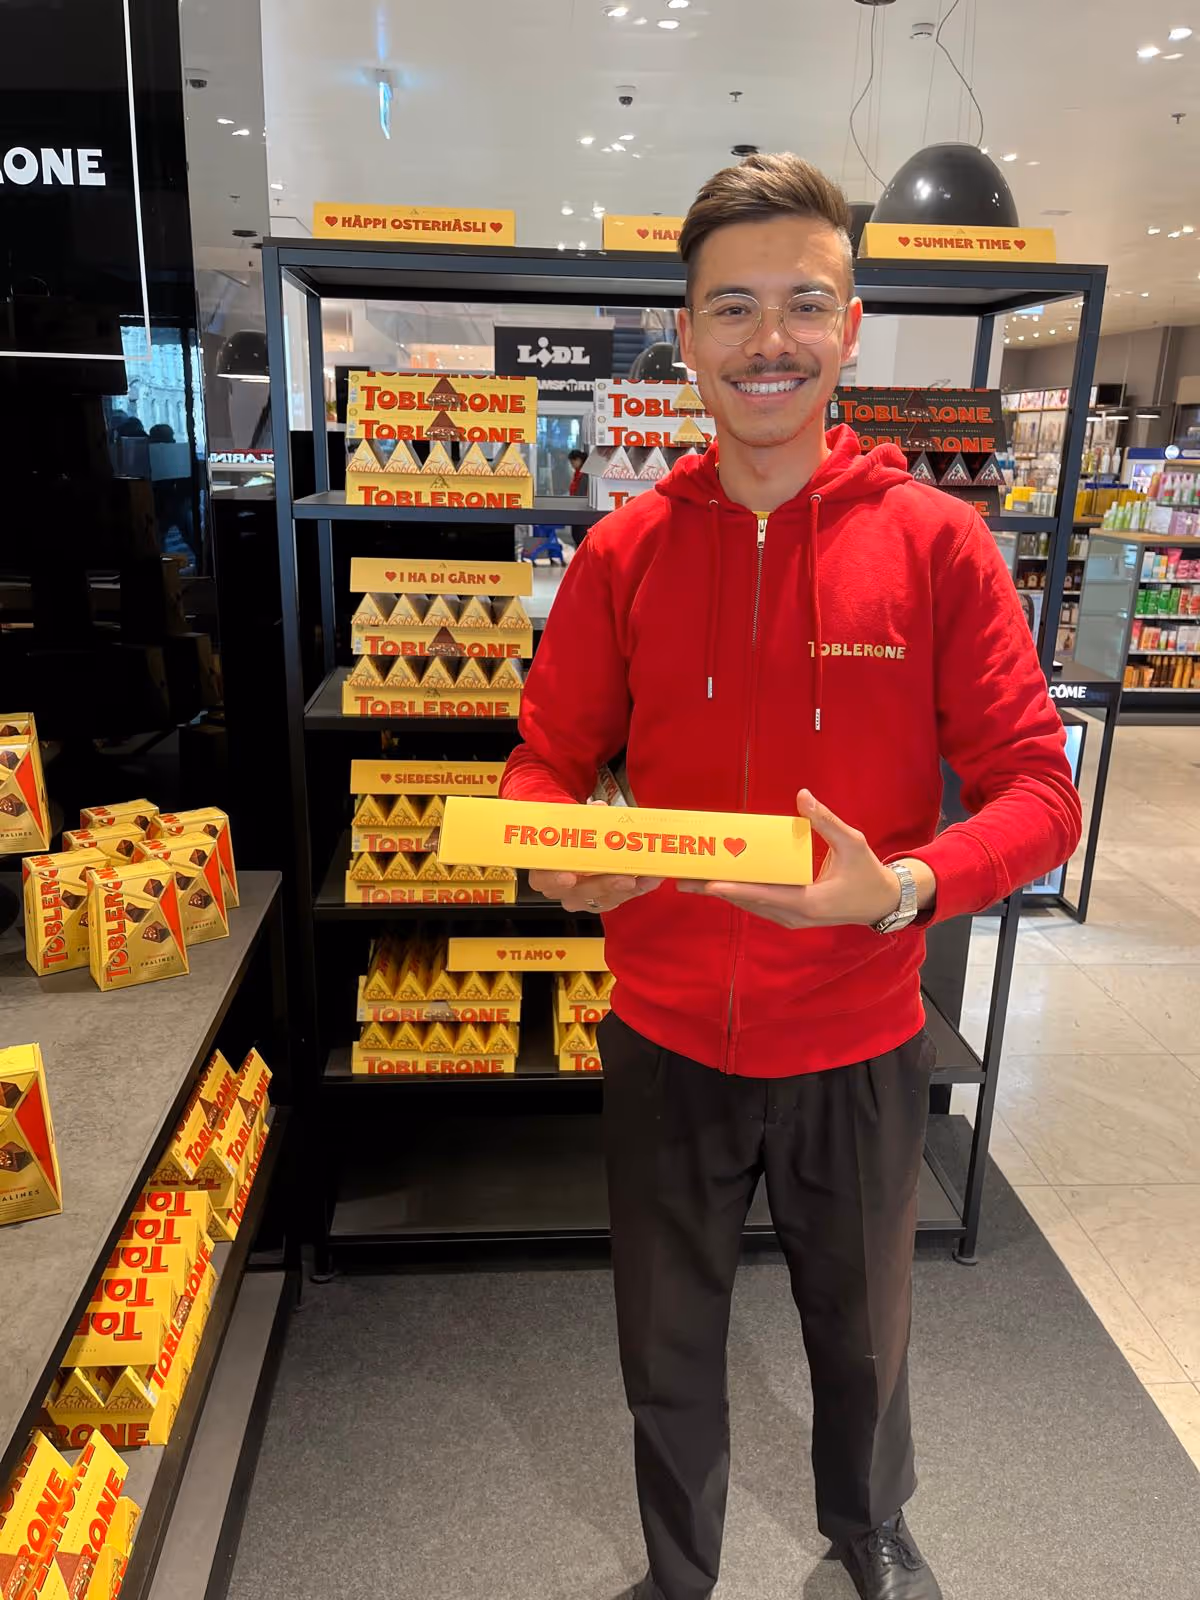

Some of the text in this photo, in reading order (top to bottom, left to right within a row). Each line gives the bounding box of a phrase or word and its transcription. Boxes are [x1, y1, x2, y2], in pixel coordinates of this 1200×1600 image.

[390, 218, 486, 233] OSTERHÄSLI
[913, 236, 1012, 250] SUMMER TIME
[358, 485, 522, 509] TOBLERONE
[400, 571, 486, 584] I HA DI GÄRN
[807, 641, 906, 660] TOBLERONE
[354, 696, 511, 718] TOBLERONE
[503, 824, 716, 856] FROHE OSTERN
[510, 950, 553, 961] TI AMO
